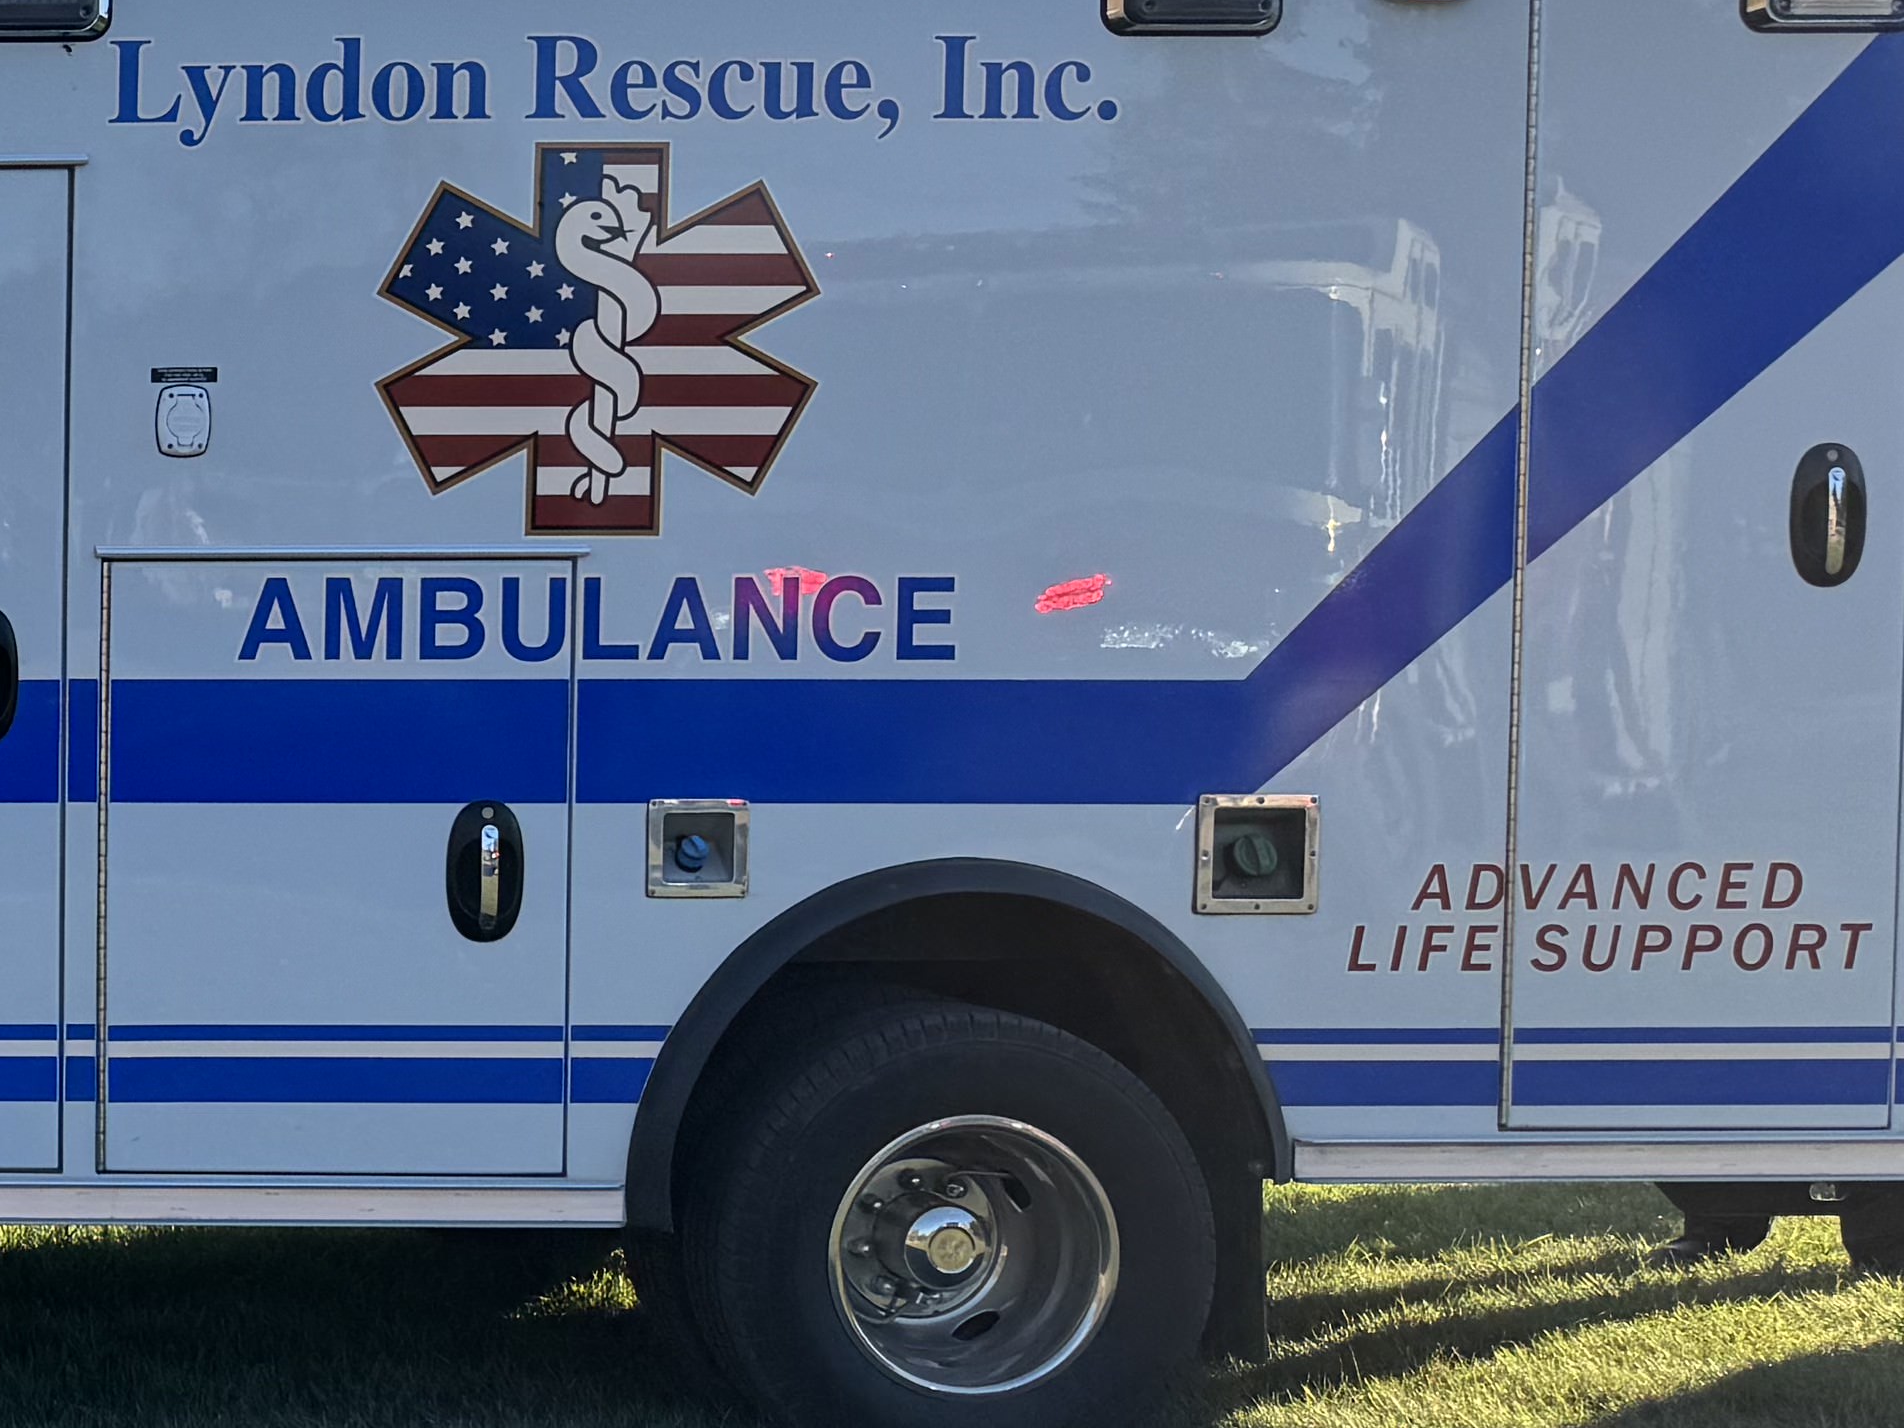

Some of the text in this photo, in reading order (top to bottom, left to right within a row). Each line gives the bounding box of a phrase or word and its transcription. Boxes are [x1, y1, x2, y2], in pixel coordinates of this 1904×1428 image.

[107, 34, 1119, 148] Lyndon Rescue, Inc.
[237, 575, 957, 663] AMBULANCE
[1410, 861, 1805, 912] ADVANCED
[1346, 922, 1874, 973] LIFE SUPPORT
